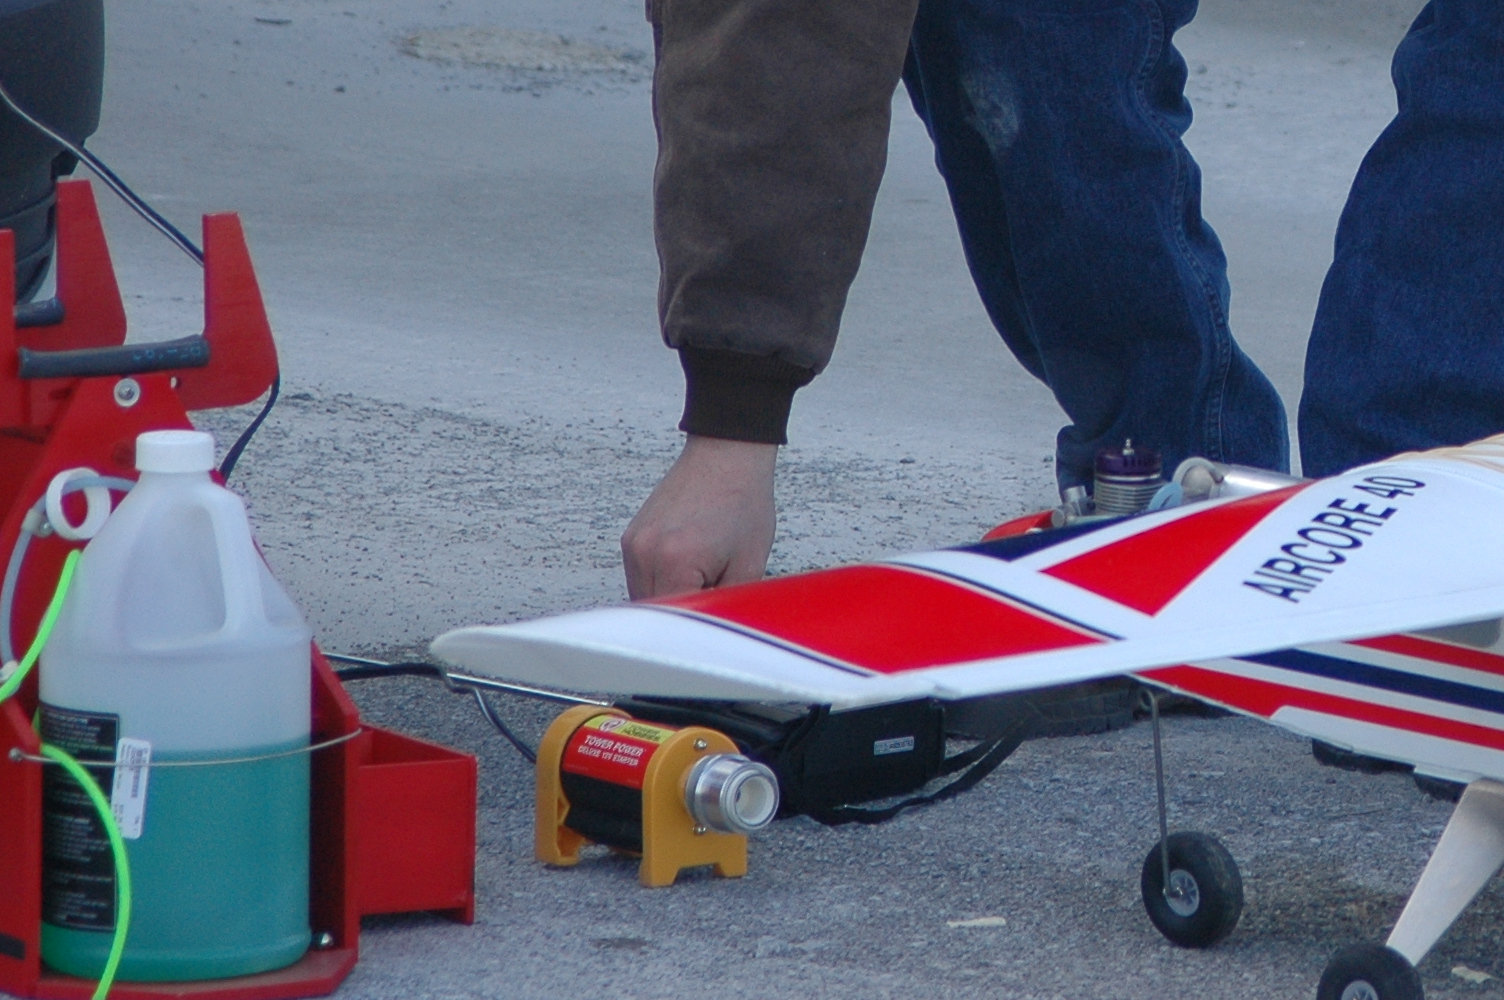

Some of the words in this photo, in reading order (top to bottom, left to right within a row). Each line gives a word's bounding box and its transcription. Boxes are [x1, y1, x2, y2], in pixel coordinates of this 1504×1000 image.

[1243, 498, 1398, 603] AIRCORE
[1353, 475, 1426, 499] 40
[584, 734, 614, 750] TOWER
[613, 741, 644, 757] POWER
